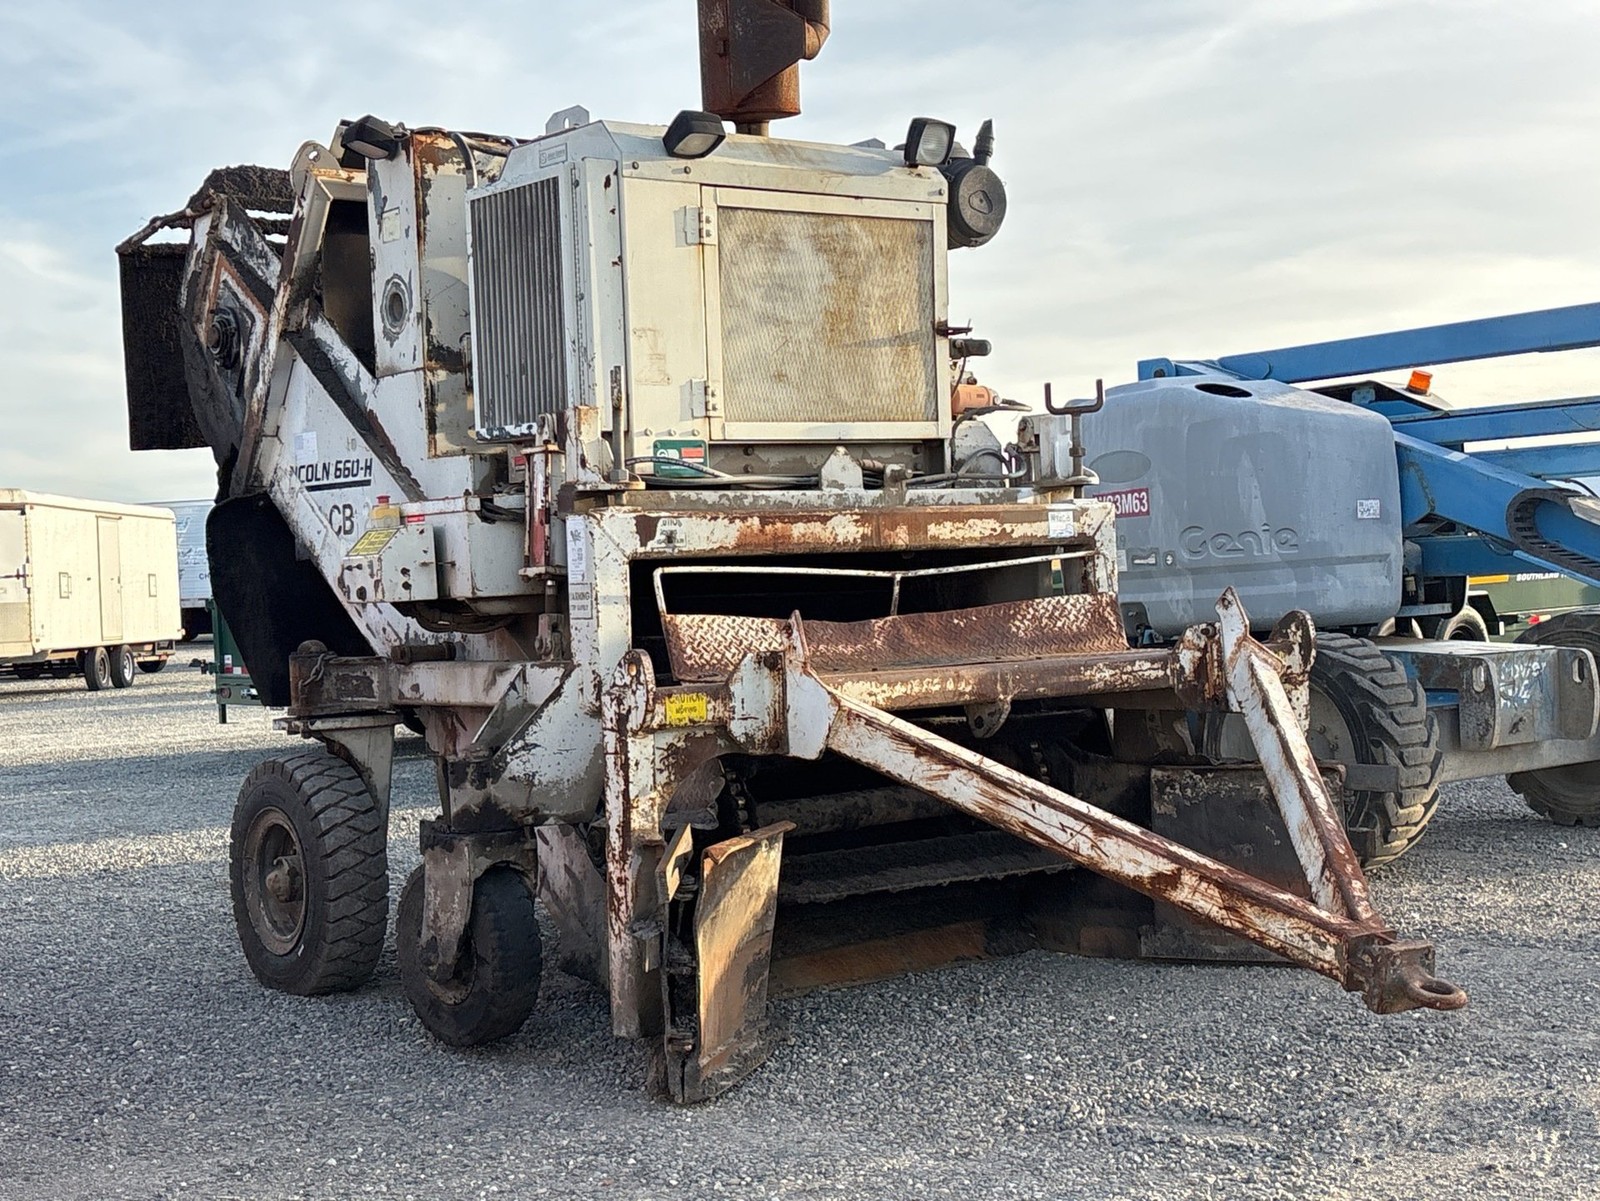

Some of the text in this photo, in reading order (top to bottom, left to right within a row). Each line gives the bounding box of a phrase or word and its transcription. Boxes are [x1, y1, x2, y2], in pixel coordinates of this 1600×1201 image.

[334, 458, 373, 479] 660-H
[329, 503, 355, 537] CB
[1179, 523, 1299, 560] Genie
